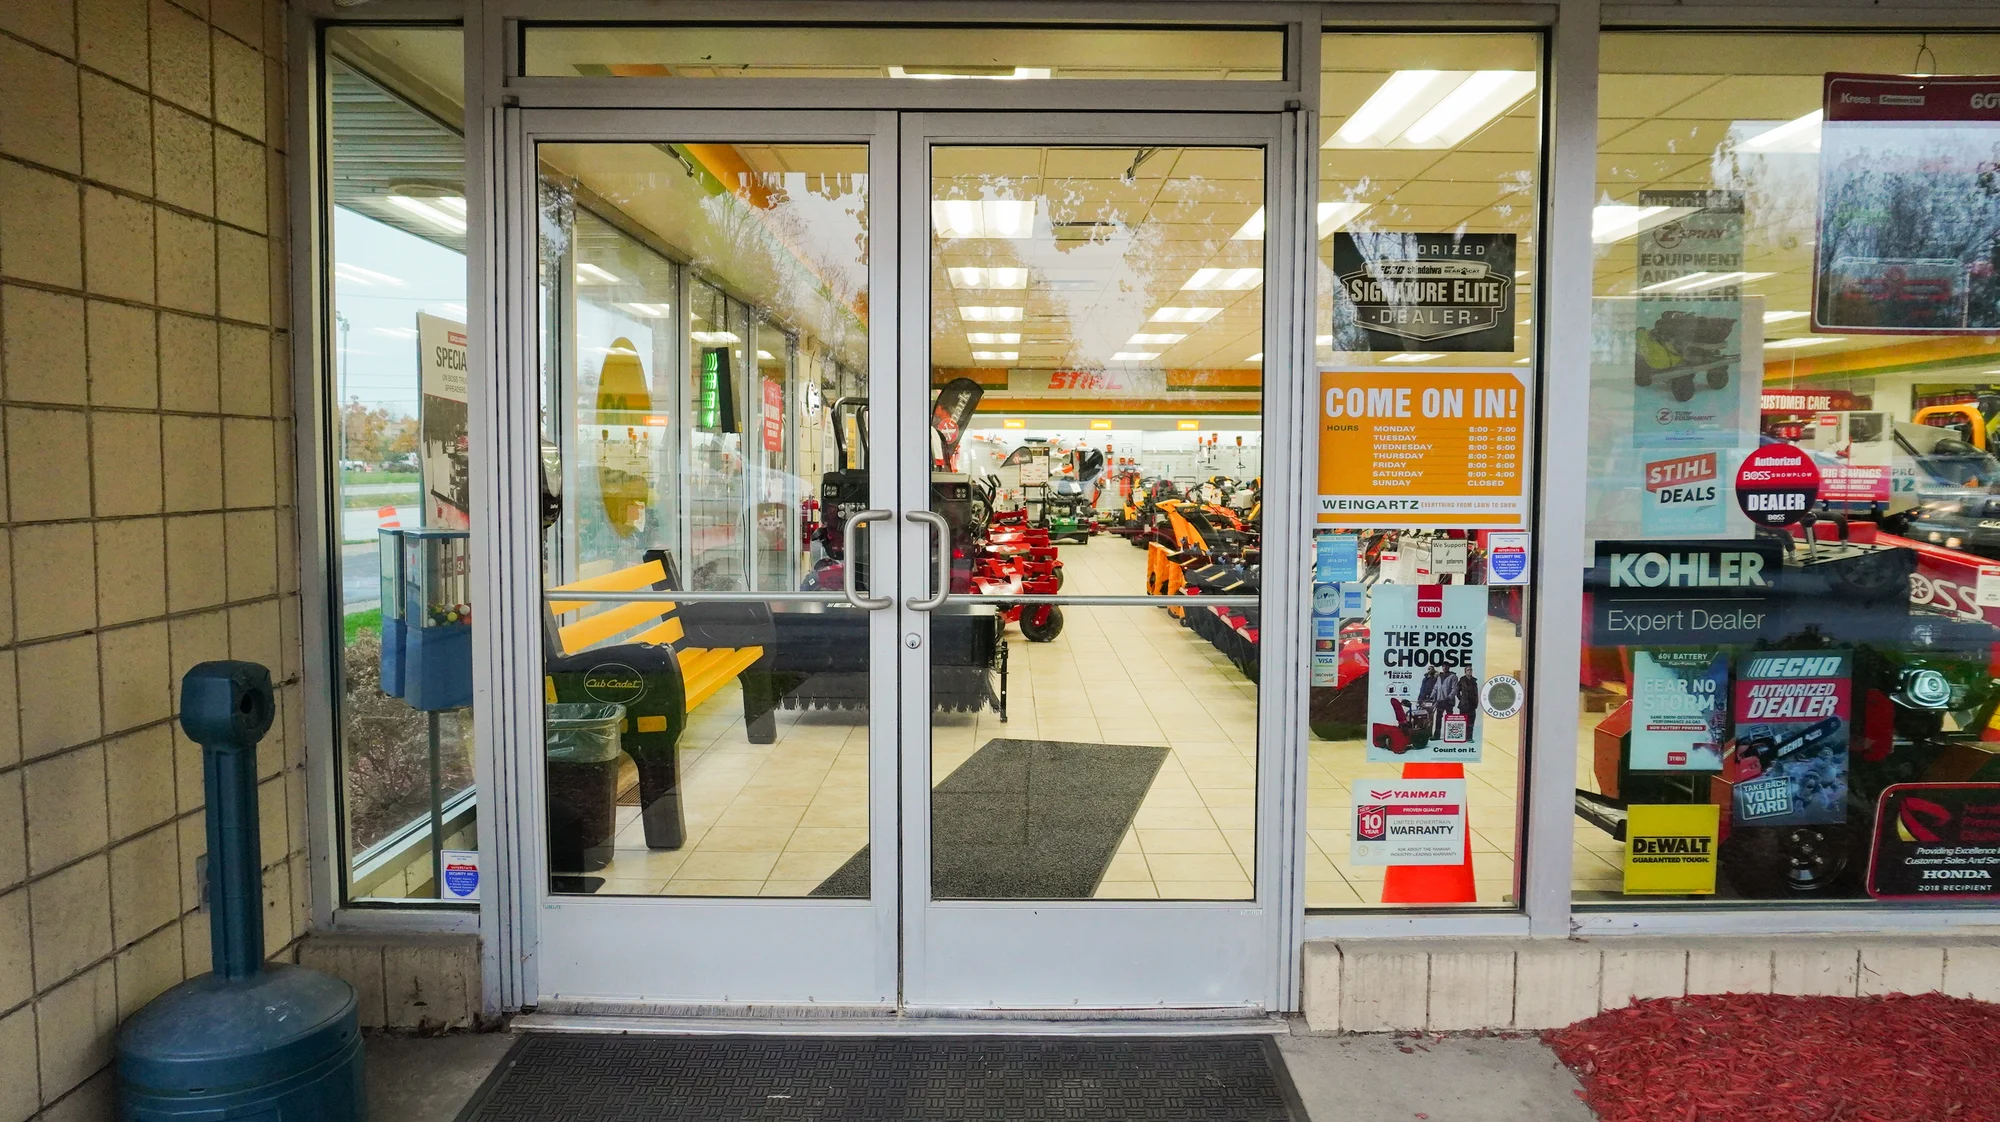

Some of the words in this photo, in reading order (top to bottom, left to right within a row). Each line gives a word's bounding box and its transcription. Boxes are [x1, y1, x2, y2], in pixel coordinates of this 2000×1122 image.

[1840, 92, 1872, 104] Kress
[1641, 253, 1740, 266] EQUIPMENT
[1642, 270, 1678, 283] AND
[1350, 279, 1448, 303] SIGNATURE
[1453, 280, 1500, 303] ELITE
[1380, 309, 1471, 324] DEALER
[1048, 371, 1123, 390] STIHL
[1325, 387, 1412, 418] COME
[1422, 388, 1464, 418] ON
[1474, 388, 1518, 418] IN!
[1807, 396, 1831, 410] CARE
[1754, 456, 1801, 466] Authorized
[1649, 458, 1712, 484] STIHL
[1743, 471, 1771, 480] BOSS
[1822, 468, 1839, 478] BIG
[1840, 468, 1882, 478] SAVINGS
[1892, 479, 1915, 492] 12
[1659, 486, 1716, 503] DEALS
[1747, 493, 1806, 511] DEALER
[1322, 499, 1419, 510] WEINGARTZ
[1609, 552, 1766, 588] KOHLER
[1607, 609, 1684, 635] Expert
[1691, 610, 1767, 629] Dealer
[1383, 631, 1420, 647] THE
[1424, 631, 1473, 648] PROS
[1383, 648, 1473, 668] CHOOSE
[1768, 656, 1842, 678] ECHO
[585, 679, 606, 688] Cub
[606, 679, 642, 688] Cadet
[1488, 676, 1517, 687] PROUD
[1644, 678, 1688, 693] FEAR
[1693, 679, 1717, 693] NO
[1748, 682, 1837, 698] AUTHORIZED
[1643, 694, 1715, 712] STORM
[1747, 695, 1840, 719] DEALER
[1487, 707, 1516, 718] DONOR
[1781, 737, 1804, 754] ECHO
[1743, 783, 1764, 792] TAKE
[1765, 779, 1787, 788] BACK
[1393, 791, 1447, 799] YANMAR
[1744, 787, 1788, 803] YOUR
[1746, 799, 1788, 816] YARD
[1361, 813, 1382, 830] 10
[1390, 825, 1454, 835] WARRANTY
[1916, 847, 1954, 856] Providing
[1954, 846, 1997, 855] Excellence
[1905, 857, 1944, 865] Customer
[1944, 857, 1967, 865] Sales
[1967, 857, 1985, 865] And
[1922, 870, 1992, 879] HONDA
